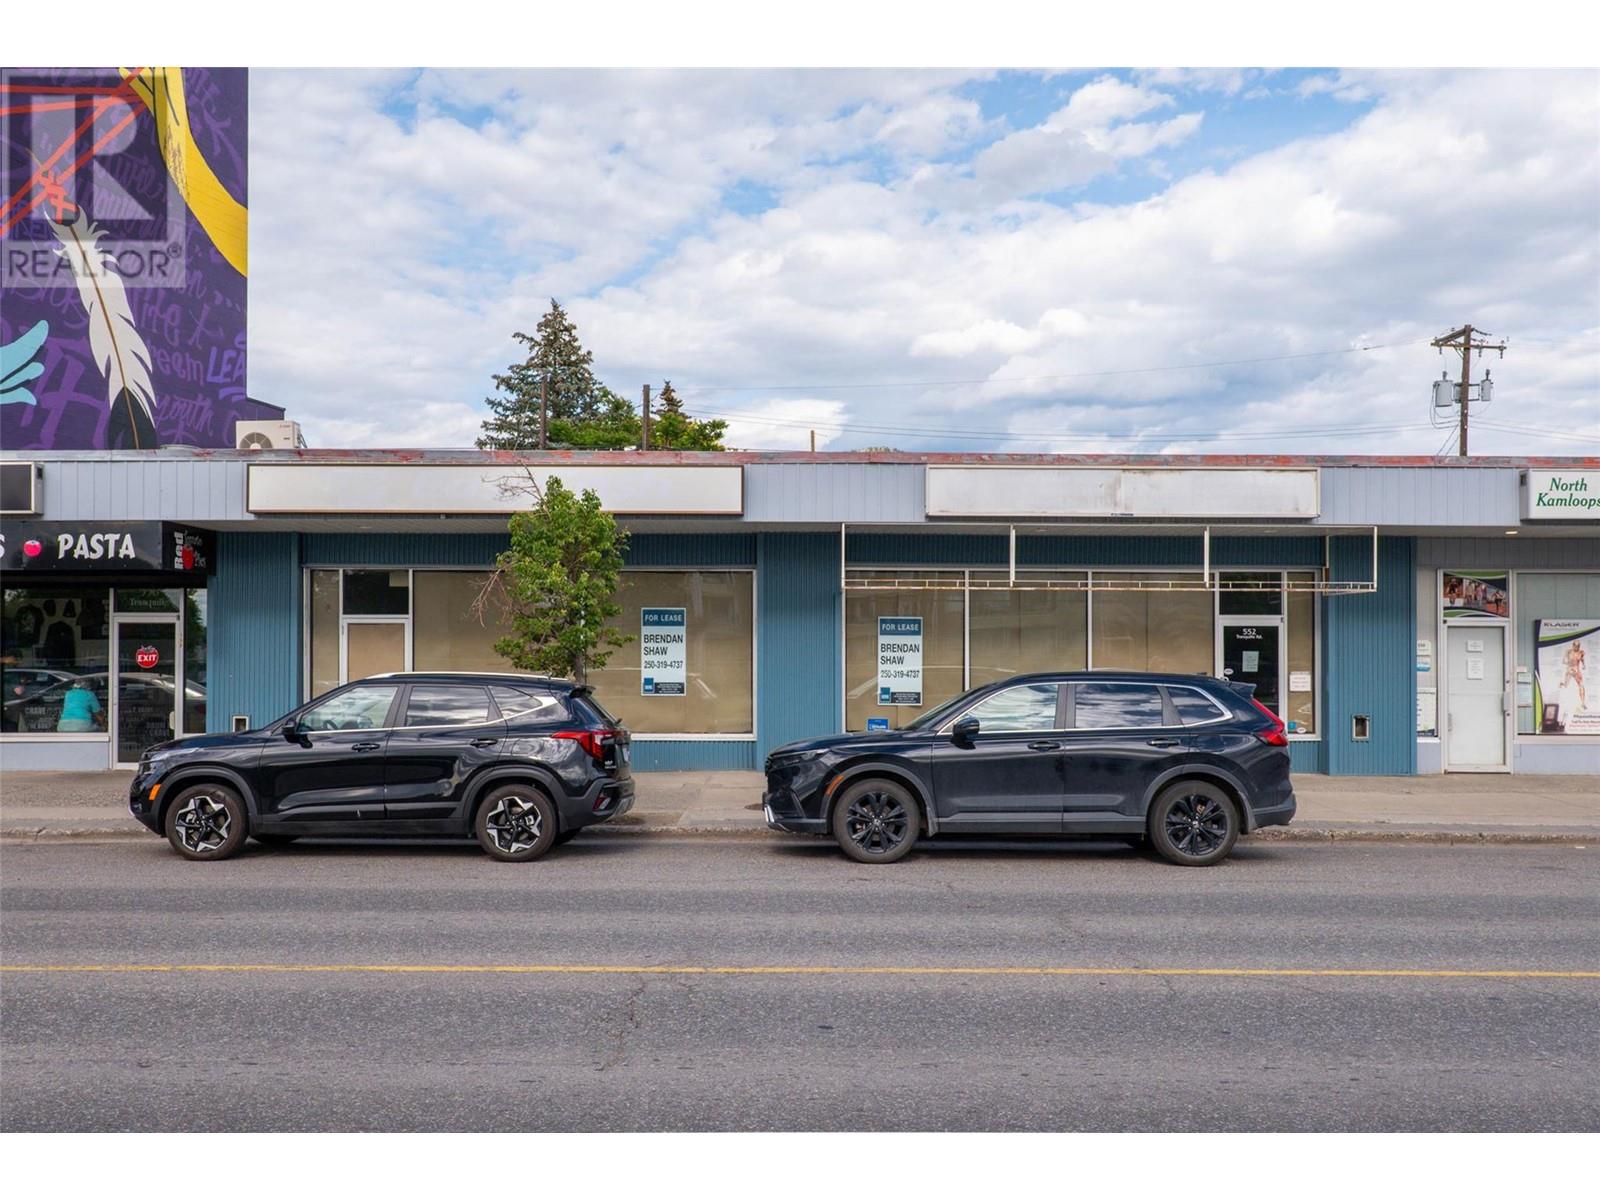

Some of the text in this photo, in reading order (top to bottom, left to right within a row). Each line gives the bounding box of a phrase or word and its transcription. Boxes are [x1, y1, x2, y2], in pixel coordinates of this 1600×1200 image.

[1549, 477, 1588, 492] North
[1536, 492, 1600, 510] Kamloops
[57, 532, 137, 560] PASTA
[881, 623, 919, 631] FOR LEASE
[643, 634, 683, 644] BRENDAN
[643, 646, 668, 656] SHAW
[880, 643, 920, 653] BRENDAN
[137, 654, 158, 662] EXIT
[880, 656, 905, 665] SHAW
[643, 660, 683, 669] 250-319-4737
[880, 670, 920, 679] 250-319-4737
